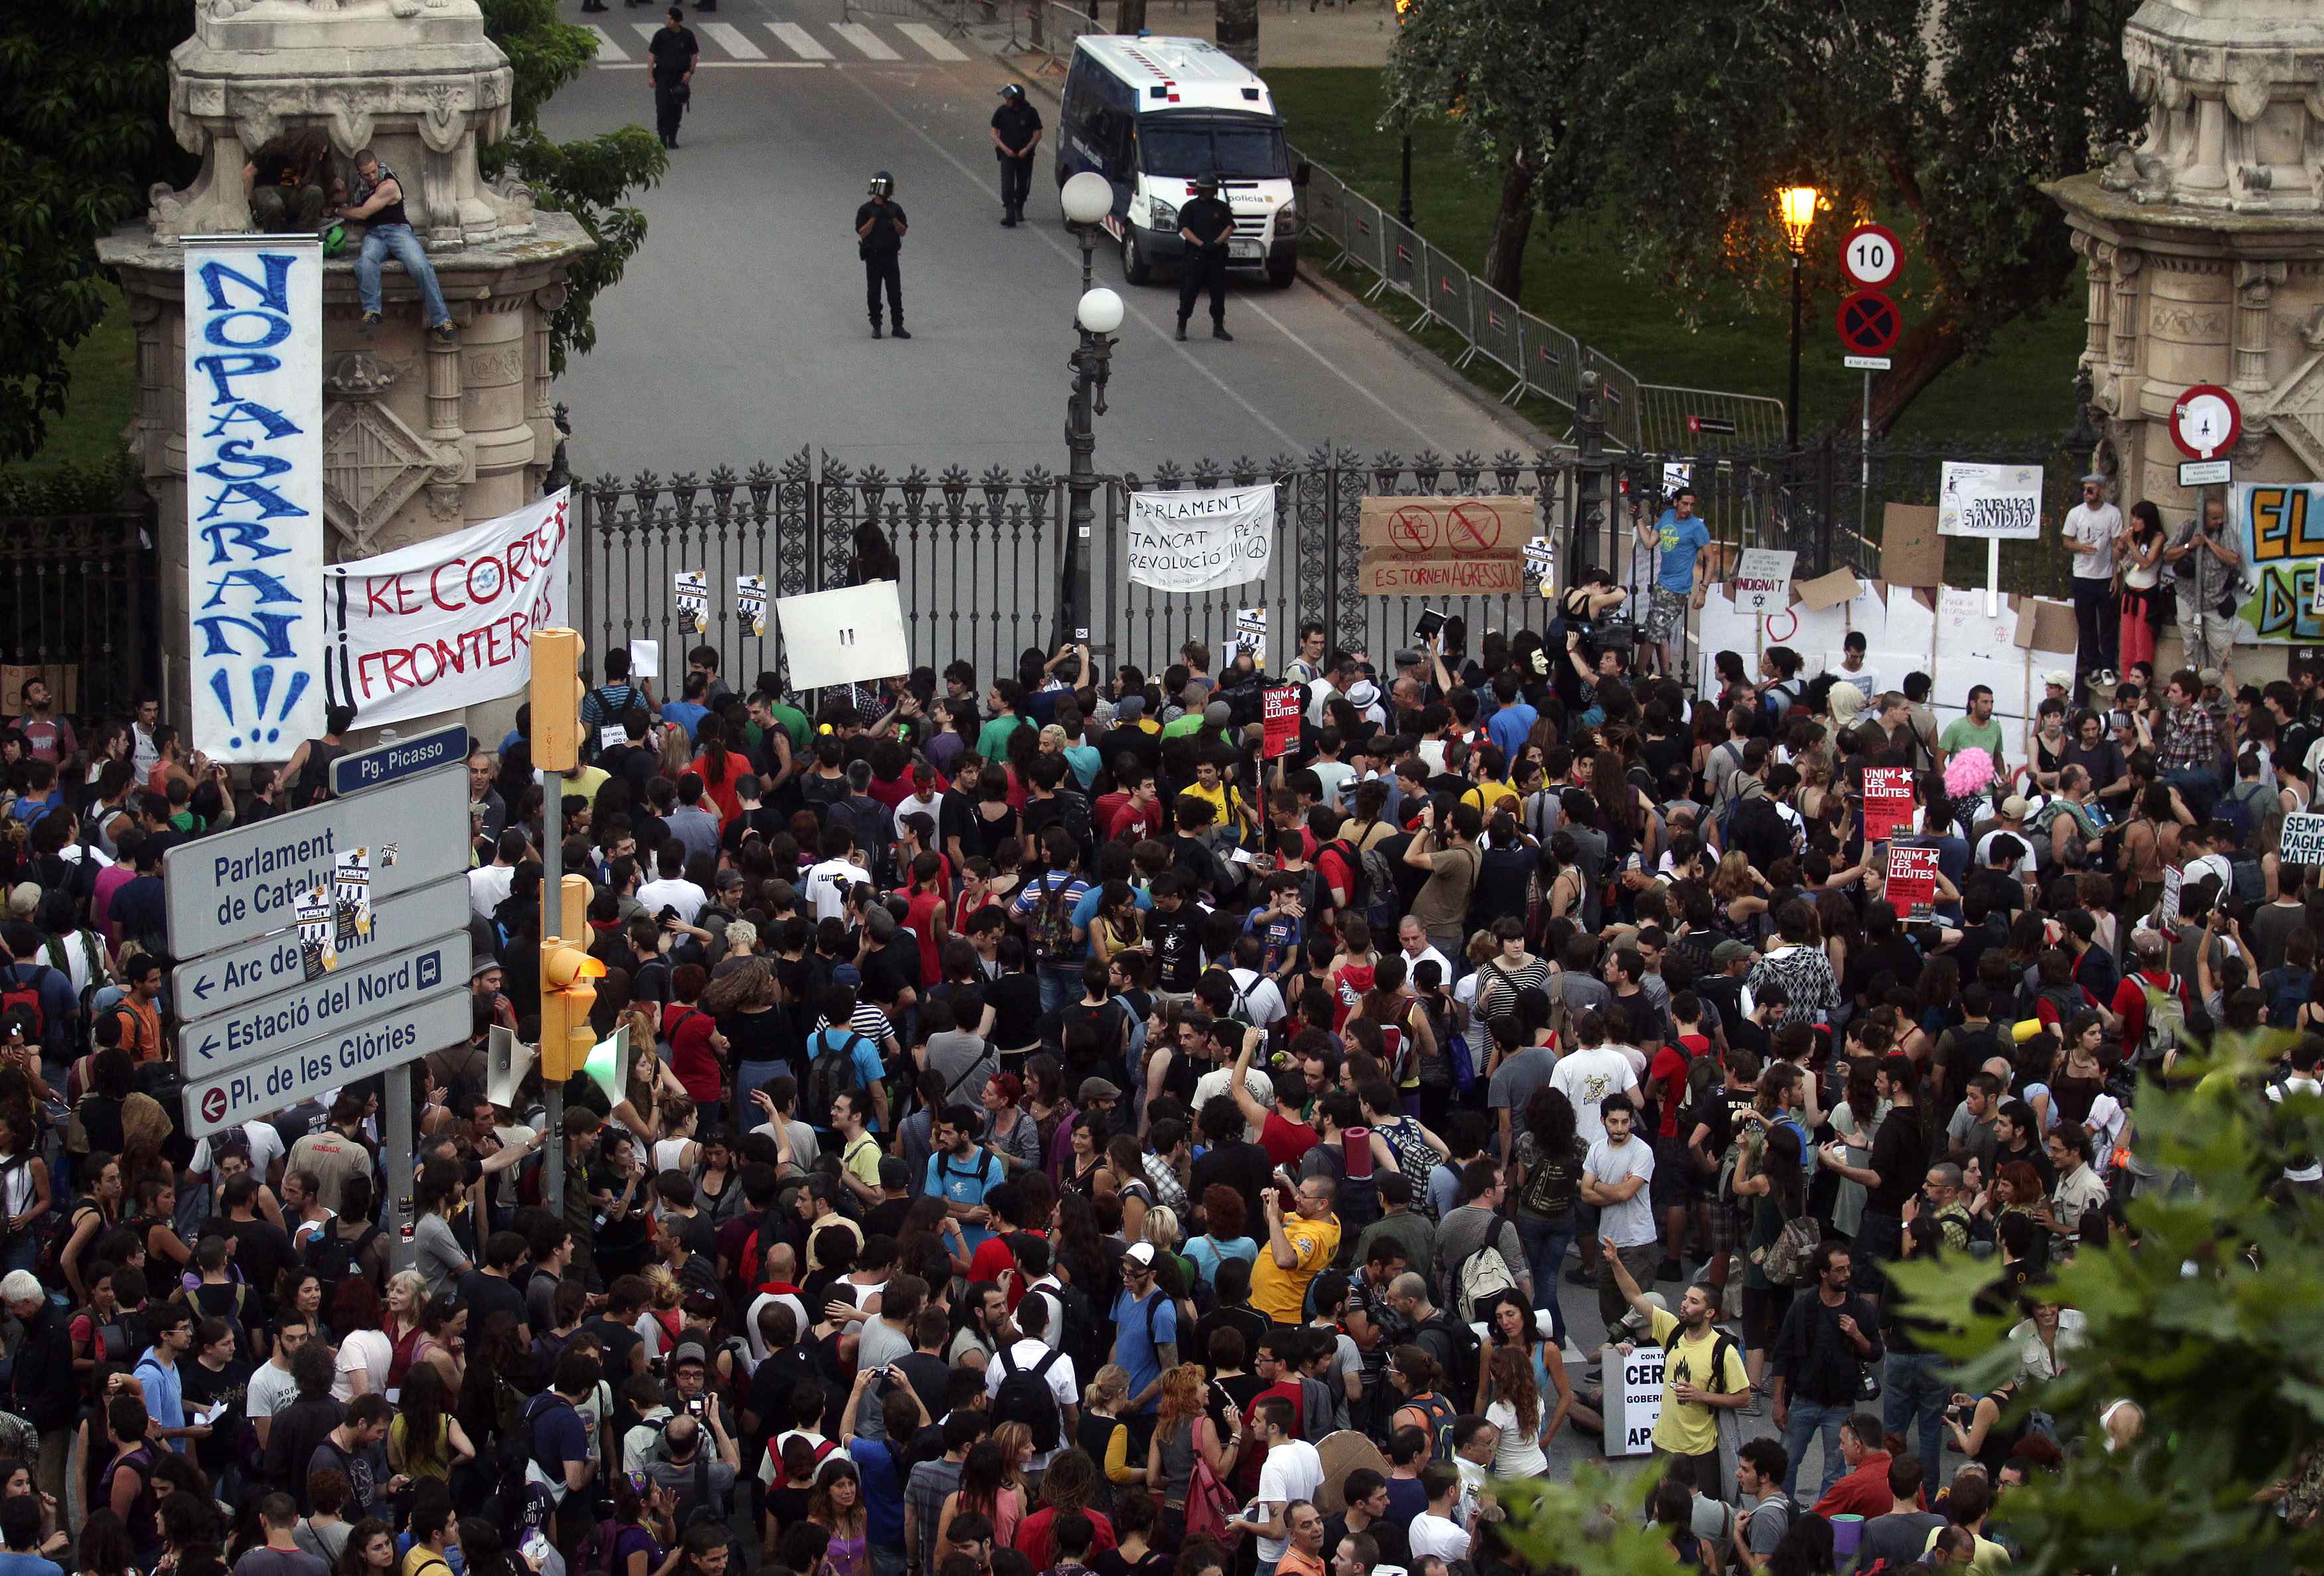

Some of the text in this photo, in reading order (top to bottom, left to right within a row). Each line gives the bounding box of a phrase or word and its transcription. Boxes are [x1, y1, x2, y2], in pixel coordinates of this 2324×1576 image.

[1857, 244, 1884, 268] 10
[1136, 495, 1244, 519] PARLAMENT
[1963, 509, 2034, 529] SANIDAD
[1130, 517, 1262, 549] TANCAT PER
[1375, 569, 1397, 587] ES
[1400, 567, 1450, 586] TORNEN
[1736, 578, 1784, 592] INDIGNA'T
[1265, 689, 1289, 701] UNIM
[1265, 699, 1282, 709] LES
[1265, 705, 1299, 719] LLUITES
[361, 742, 443, 780] Pg. Picasso
[1865, 769, 1895, 778] UNIM
[1865, 778, 1885, 788] LES
[1865, 788, 1910, 798] LLUITES
[215, 828, 335, 887] Parlament
[1892, 849, 1923, 861] UNIM
[1891, 859, 1911, 869] LES
[1889, 869, 1934, 880] LLUITES
[218, 895, 246, 926] de
[224, 960, 262, 992] Arc
[270, 945, 297, 975] de
[228, 997, 309, 1051] Estació
[317, 982, 350, 1019] del
[358, 961, 409, 1005] Nord
[231, 1024, 416, 1109] Pl. de les Glòries
[1627, 1395, 1662, 1403] GOBER
